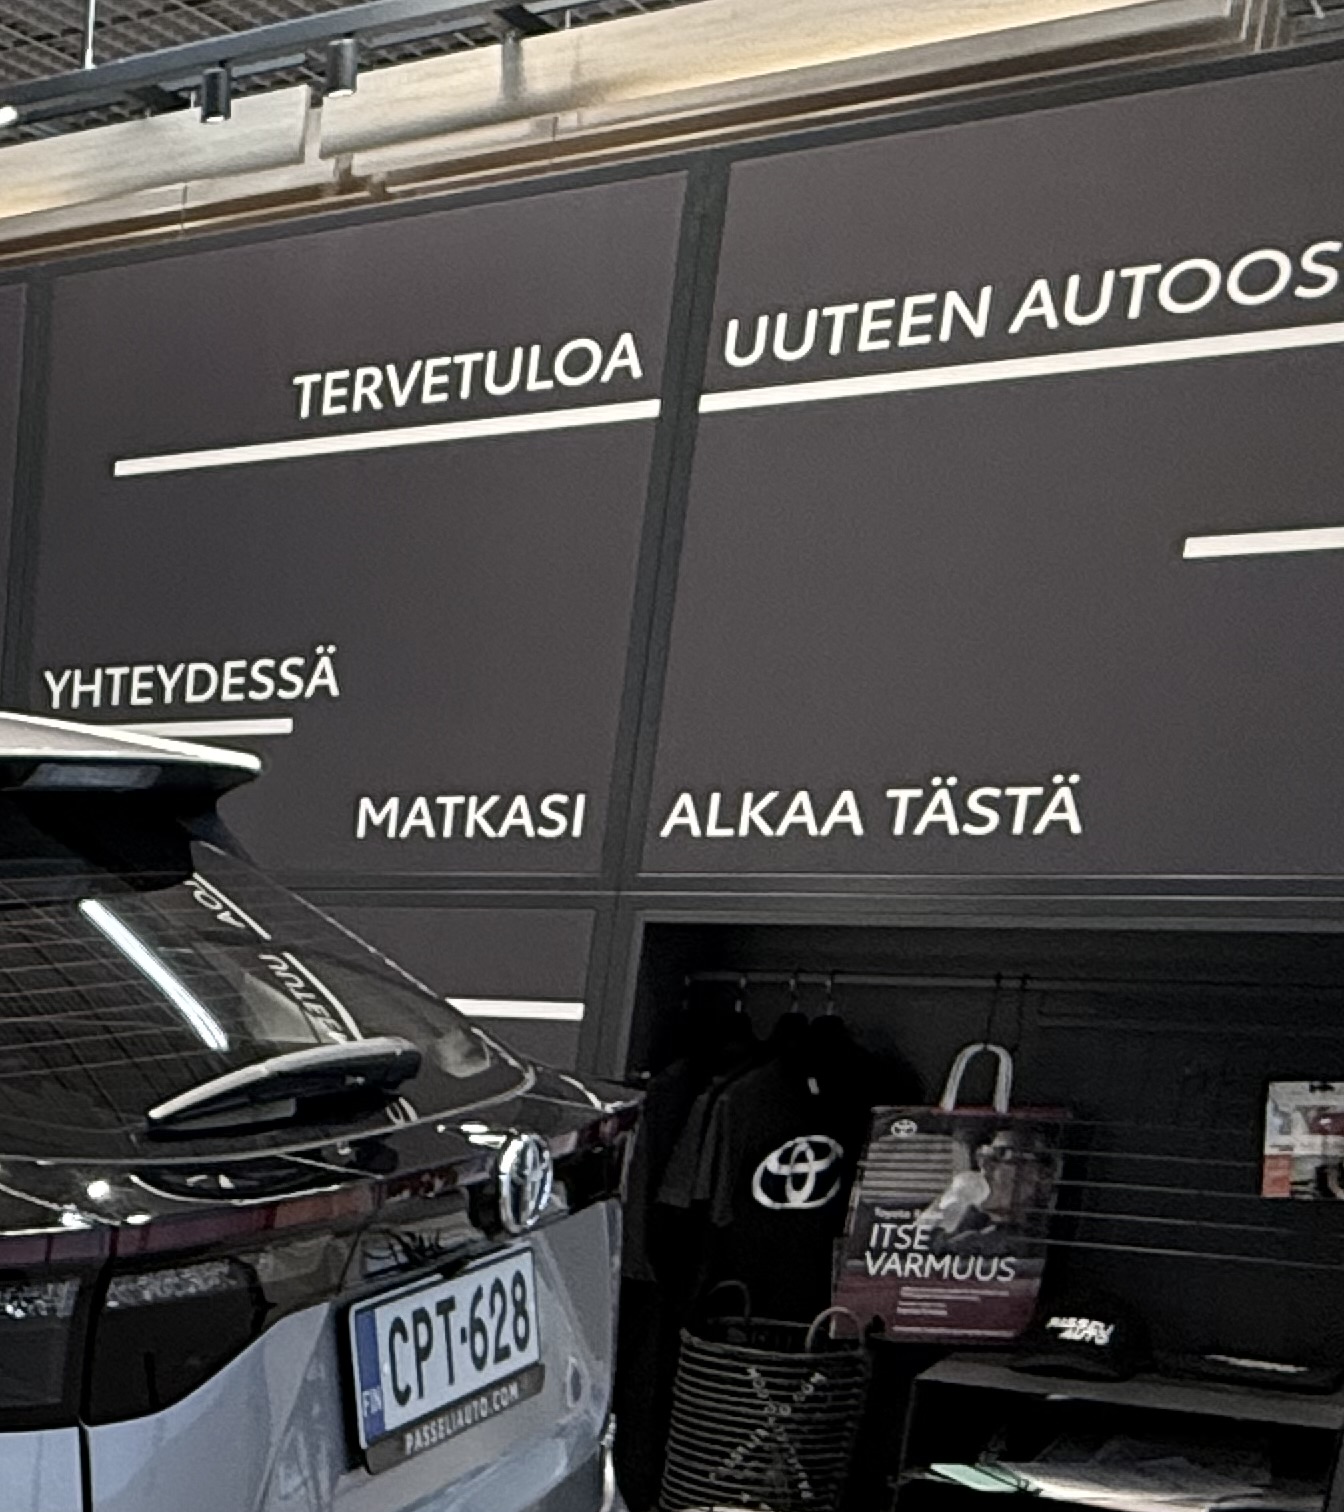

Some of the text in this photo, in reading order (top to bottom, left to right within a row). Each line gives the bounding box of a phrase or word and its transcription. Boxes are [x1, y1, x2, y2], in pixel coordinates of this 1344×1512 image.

[724, 240, 1343, 368] UUTEEN AUTOOS
[292, 332, 644, 420] TERVETULOA
[44, 643, 341, 710] YHTEYDESSÄ
[356, 792, 587, 839] MATKASI
[660, 773, 1083, 838] ALKAA TÄSTÄ
[864, 1250, 1019, 1282] VARMUUS
[869, 1222, 934, 1250] ITSE
[388, 1269, 531, 1407] CPT-628
[403, 1381, 520, 1456] PASSELIAUTO.COM
